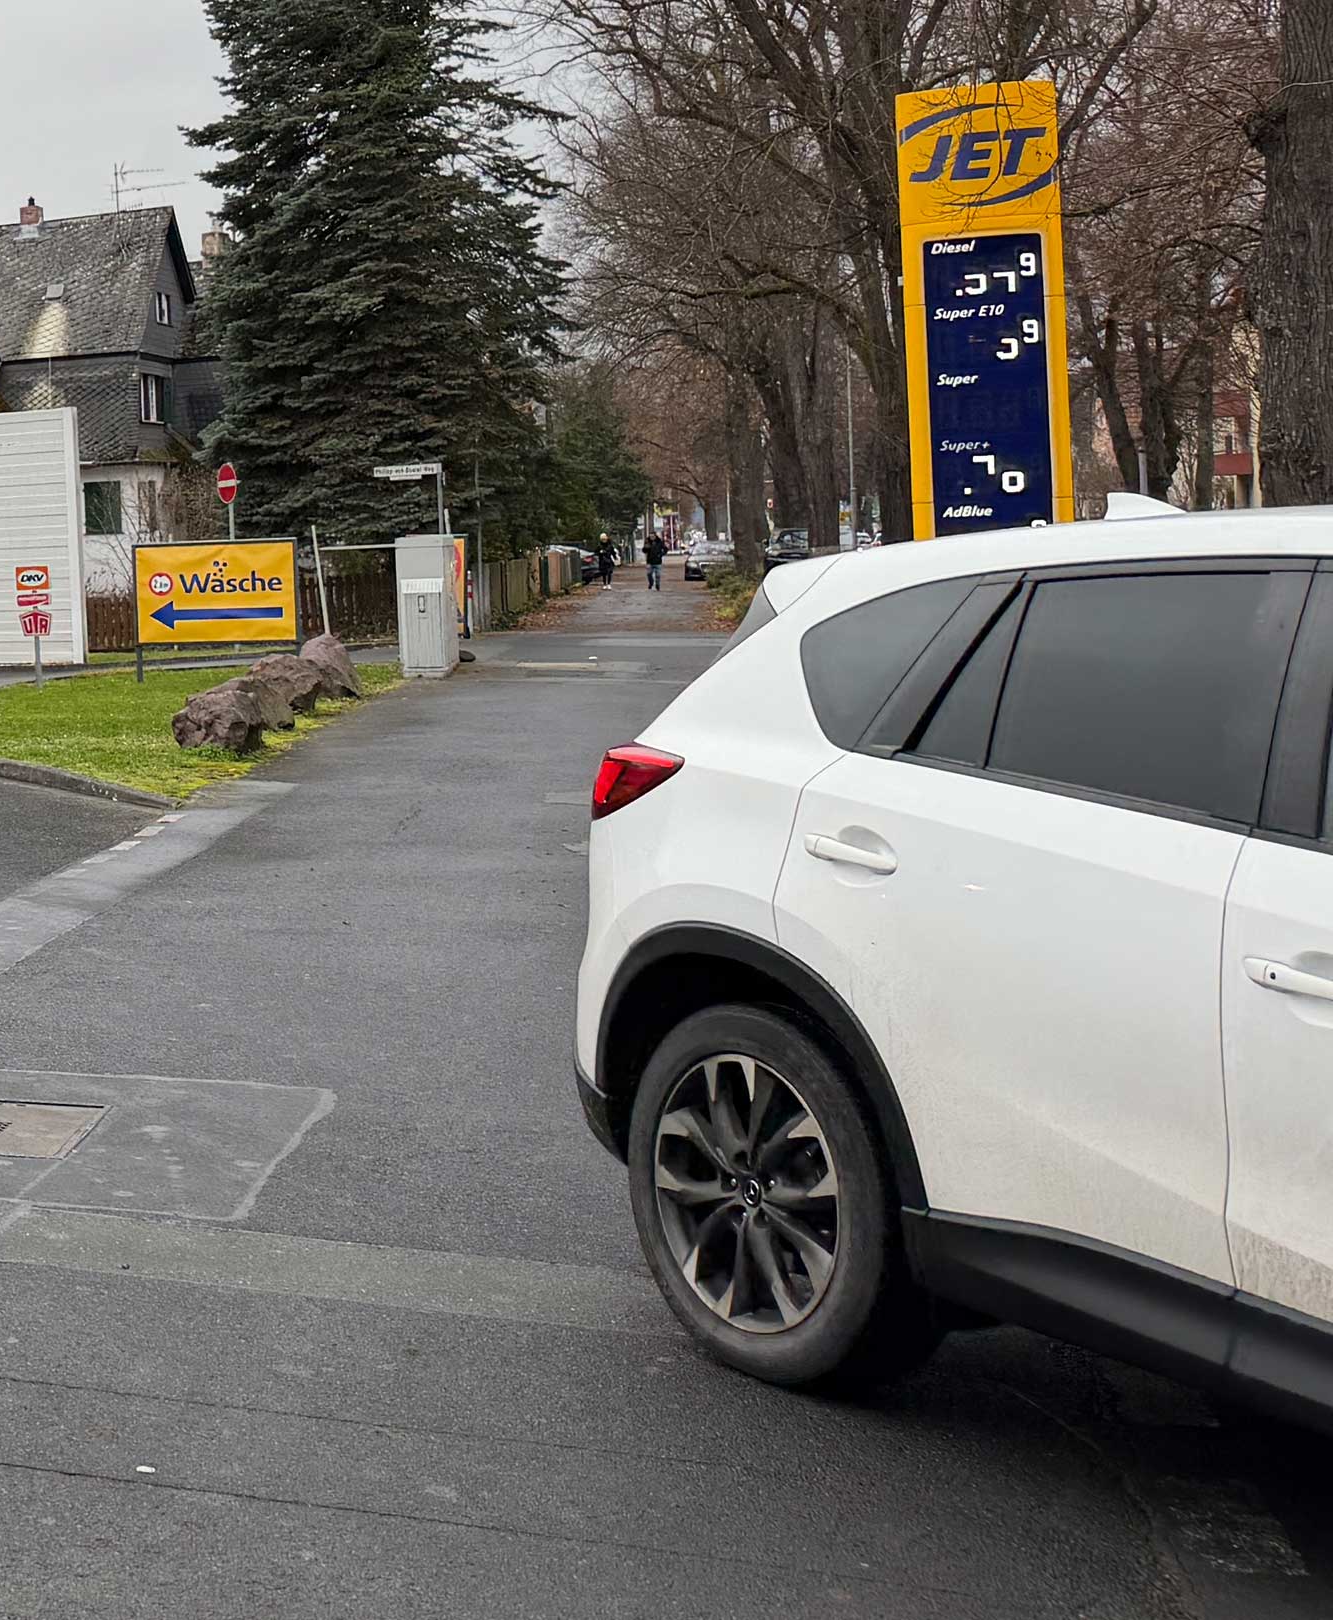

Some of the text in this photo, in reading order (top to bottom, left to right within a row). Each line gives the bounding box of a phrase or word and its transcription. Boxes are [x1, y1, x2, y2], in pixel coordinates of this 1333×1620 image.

[909, 127, 1047, 182] JET
[931, 240, 975, 254] Diesel
[934, 304, 1004, 321] Super E10
[937, 374, 978, 387] Super
[940, 440, 990, 453] Super+
[943, 505, 993, 518] AdBlue
[21, 574, 44, 582] DKV
[179, 570, 283, 593] Wäsche
